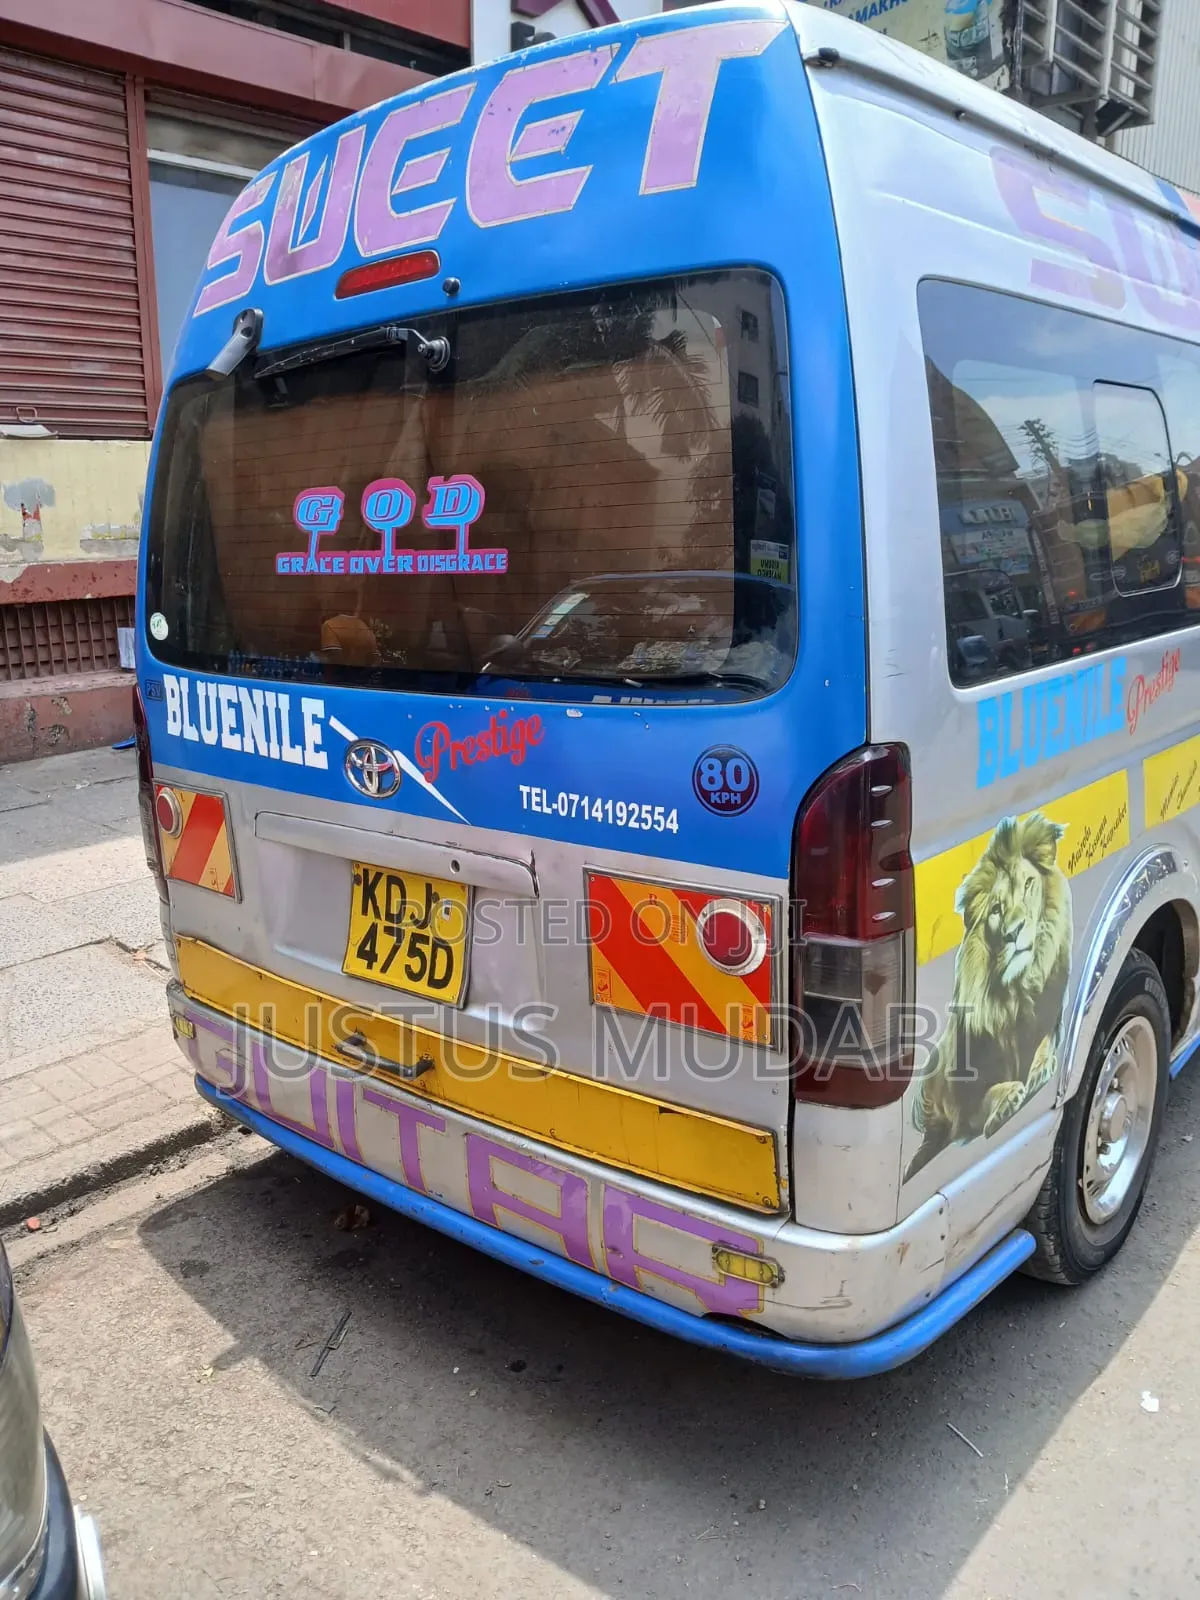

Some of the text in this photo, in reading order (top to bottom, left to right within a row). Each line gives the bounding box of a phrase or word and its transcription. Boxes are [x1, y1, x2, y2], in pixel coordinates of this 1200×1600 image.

[192, 18, 791, 318] SWEET
[277, 552, 507, 574] GRACE OVER DISGRACE
[163, 674, 545, 783] BLUENILE Prestige
[976, 656, 1128, 790] BLUENILE
[1127, 648, 1181, 736] Prestige
[700, 757, 750, 792] 80
[710, 791, 742, 804] KPH
[519, 784, 679, 834] TEL-0714192554
[361, 868, 434, 930] KDJ
[356, 921, 455, 990] 475D
